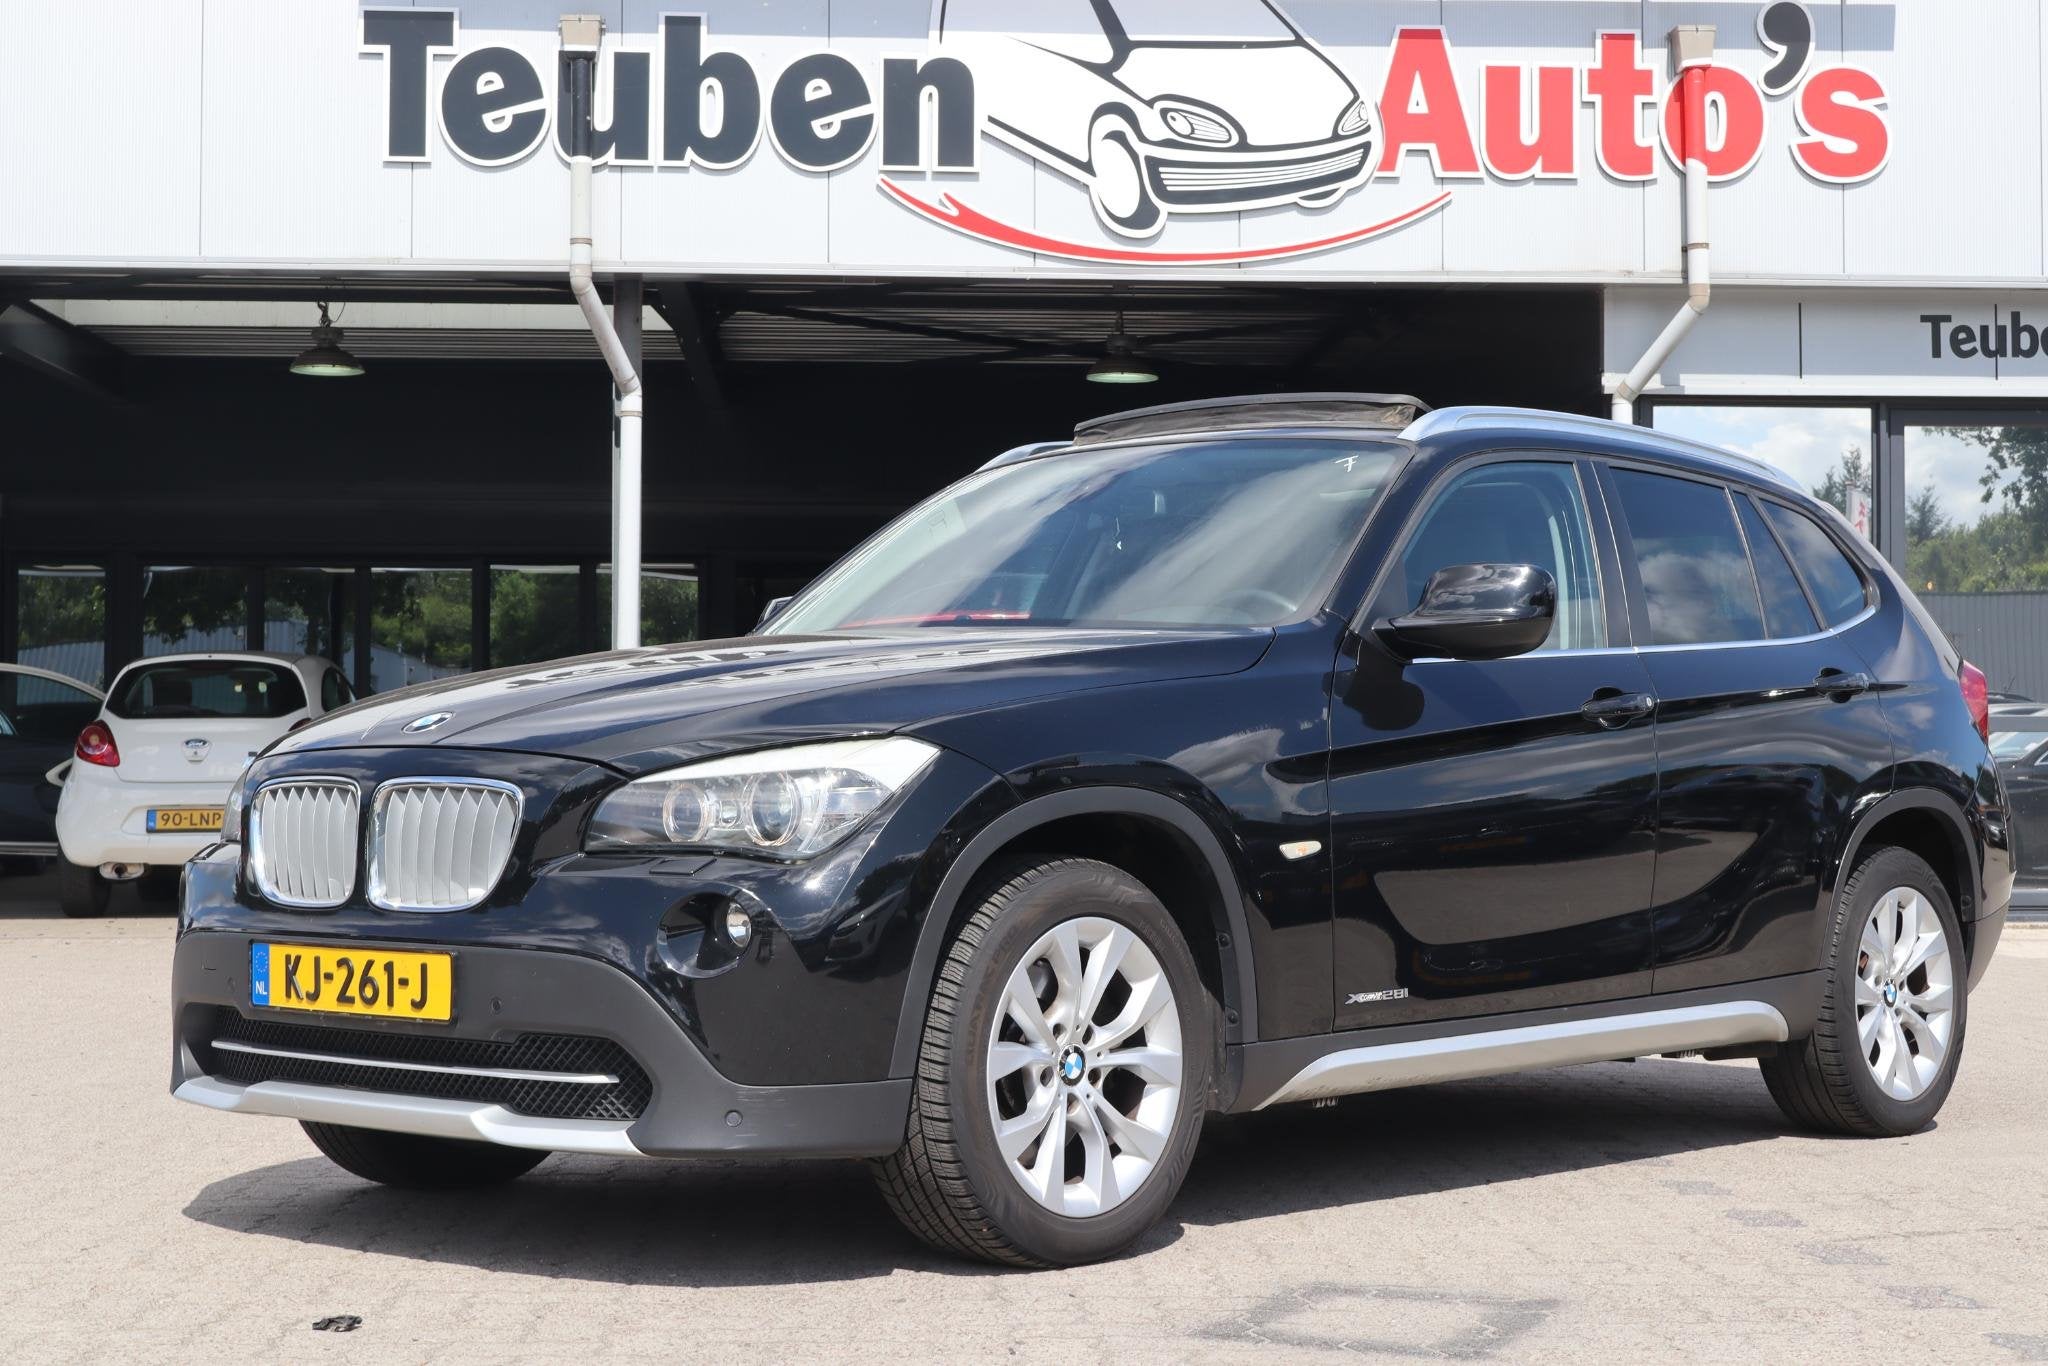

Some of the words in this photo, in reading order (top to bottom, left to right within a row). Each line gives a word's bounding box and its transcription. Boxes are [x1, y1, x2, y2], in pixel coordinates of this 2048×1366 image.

[363, 10, 976, 168] Teuben
[1376, 1, 1890, 180] Auto's
[1920, 311, 2048, 359] Teub
[255, 981, 268, 995] NL
[284, 953, 429, 1010] KJ-261-J
